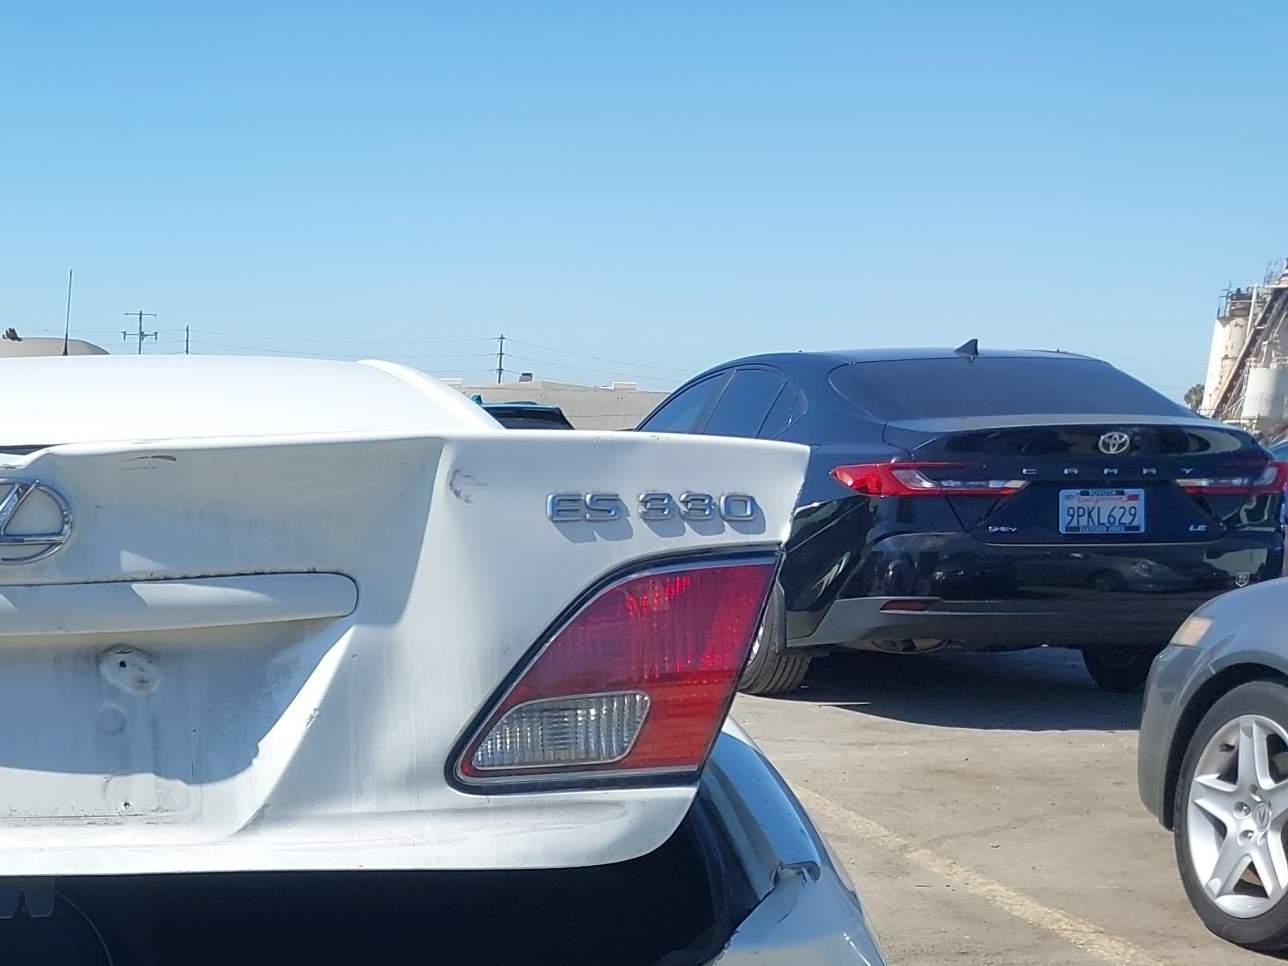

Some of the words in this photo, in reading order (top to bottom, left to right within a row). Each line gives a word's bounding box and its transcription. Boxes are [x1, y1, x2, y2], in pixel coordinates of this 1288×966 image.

[1021, 468, 1194, 476] CAMRY
[547, 492, 620, 522] ES
[638, 492, 756, 522] 330
[1066, 505, 1138, 527] 9PKL629
